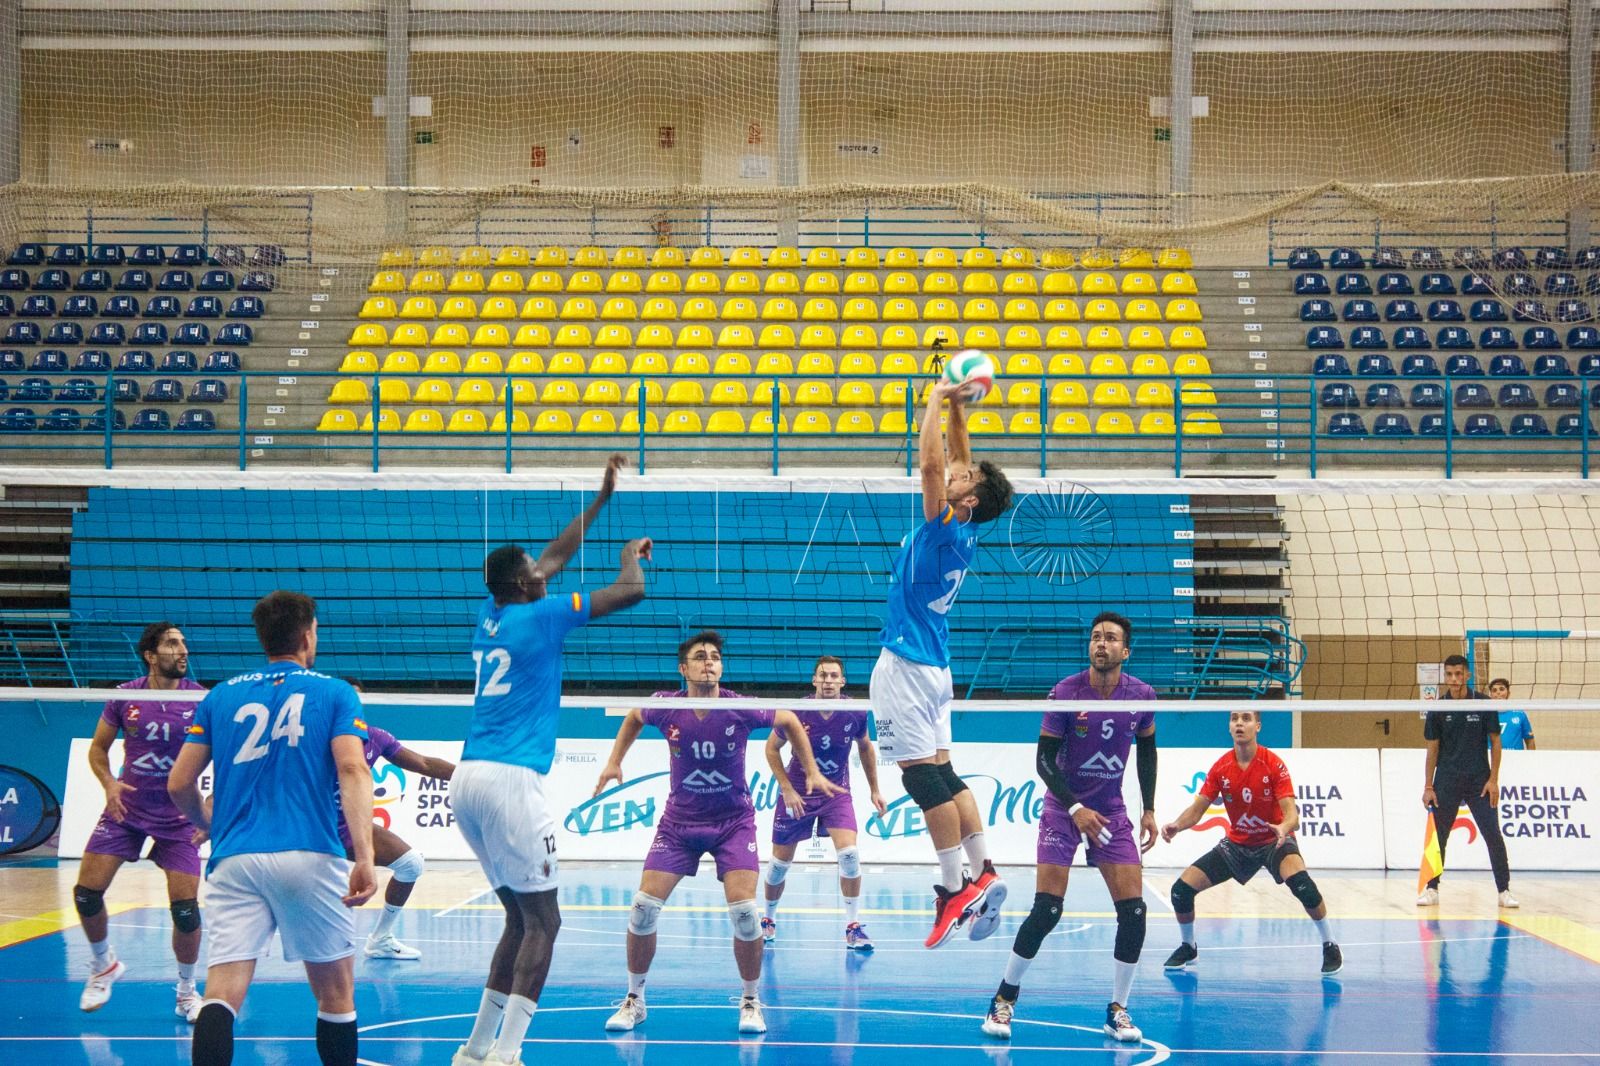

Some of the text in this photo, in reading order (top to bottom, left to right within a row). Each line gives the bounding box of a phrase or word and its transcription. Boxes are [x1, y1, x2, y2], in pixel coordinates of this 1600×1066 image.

[872, 146, 878, 154] 2
[928, 570, 967, 614] 2
[472, 648, 512, 697] 12
[145, 721, 170, 742] 21
[233, 694, 305, 765] 24
[1101, 719, 1114, 740] 5
[691, 741, 716, 759] 10
[820, 735, 830, 750] 3
[1242, 788, 1252, 803] 6
[1500, 786, 1587, 801] MELILLA
[571, 797, 655, 836] VEN
[1501, 804, 1570, 819] SPORT
[872, 806, 930, 840] VE
[1502, 822, 1591, 838] CAPITAL
[544, 835, 556, 854] 12
